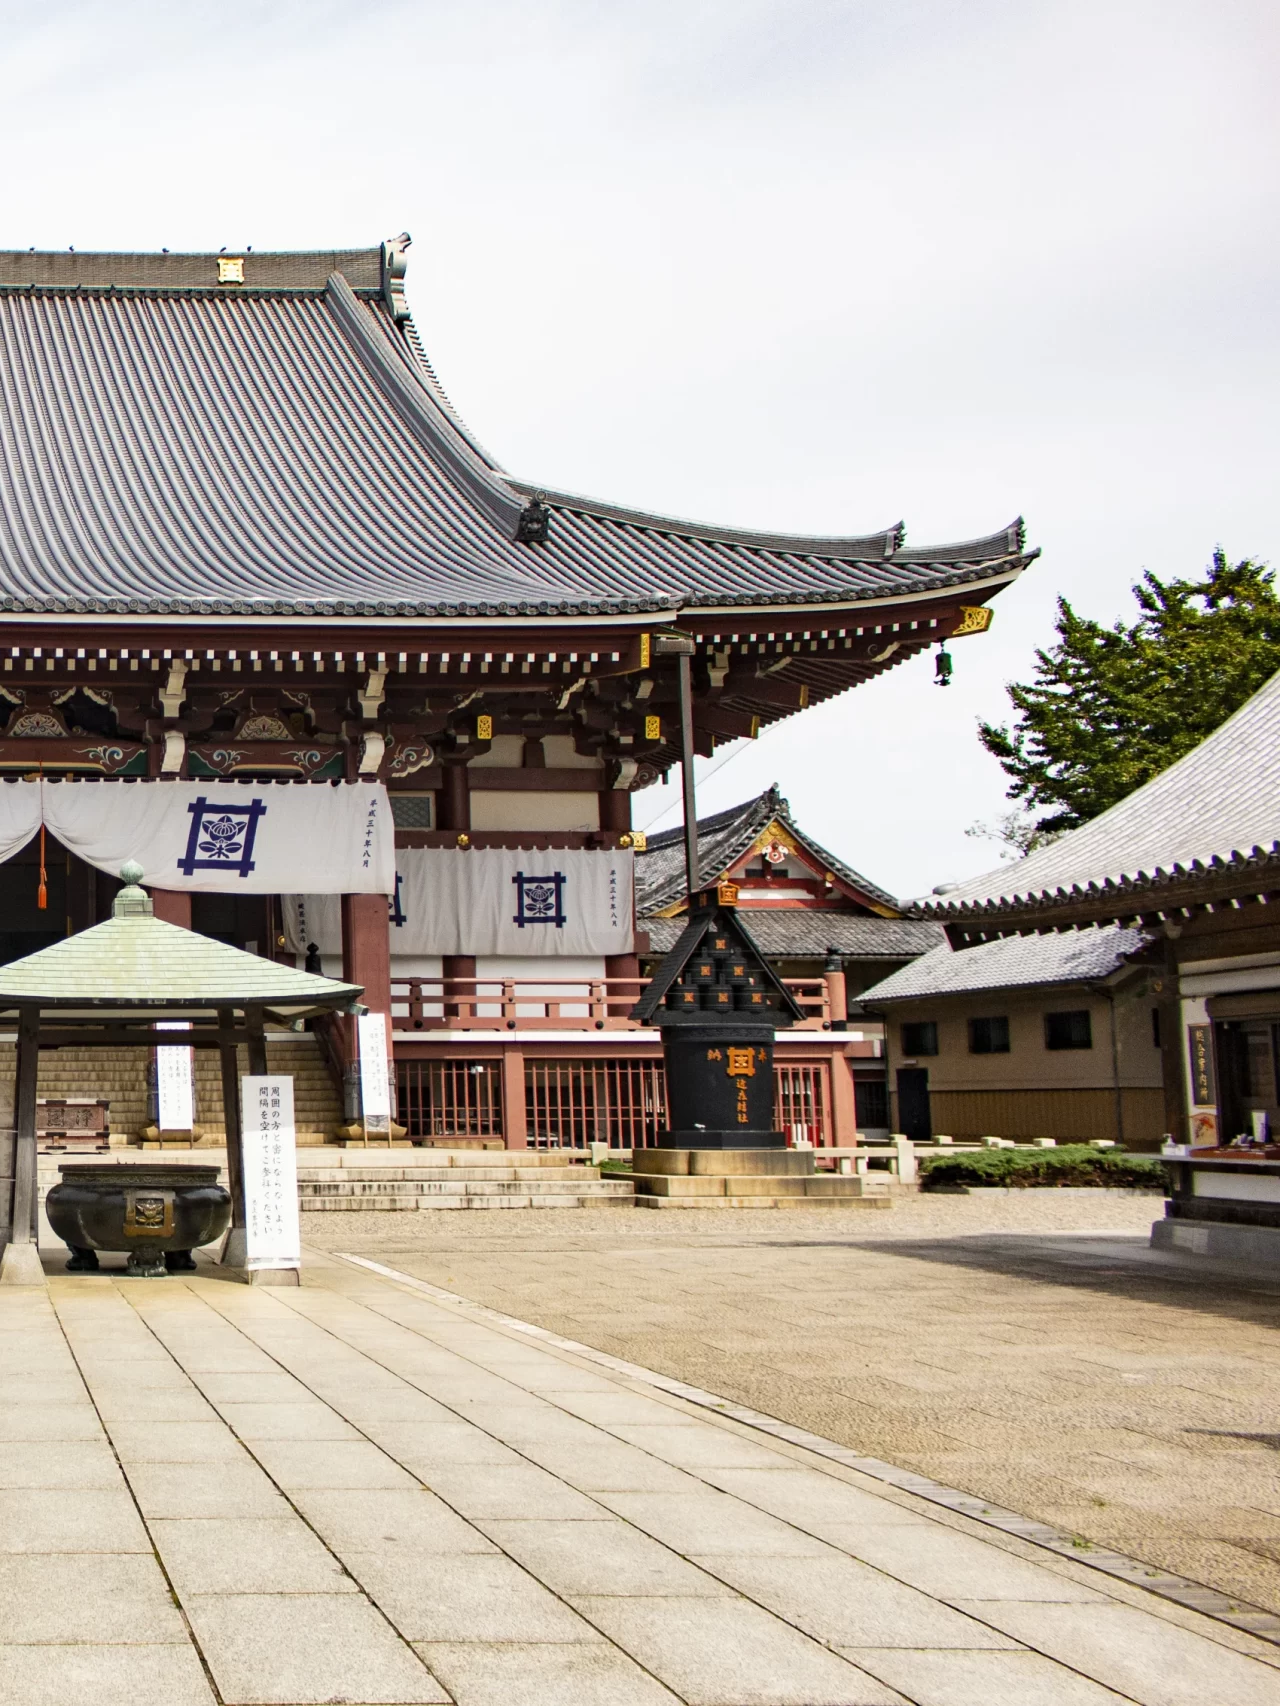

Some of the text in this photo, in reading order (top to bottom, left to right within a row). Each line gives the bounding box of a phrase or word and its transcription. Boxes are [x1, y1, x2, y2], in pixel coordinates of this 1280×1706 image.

[363, 799, 378, 868] 平成三十年八月
[609, 869, 618, 927] 平成三十年八月
